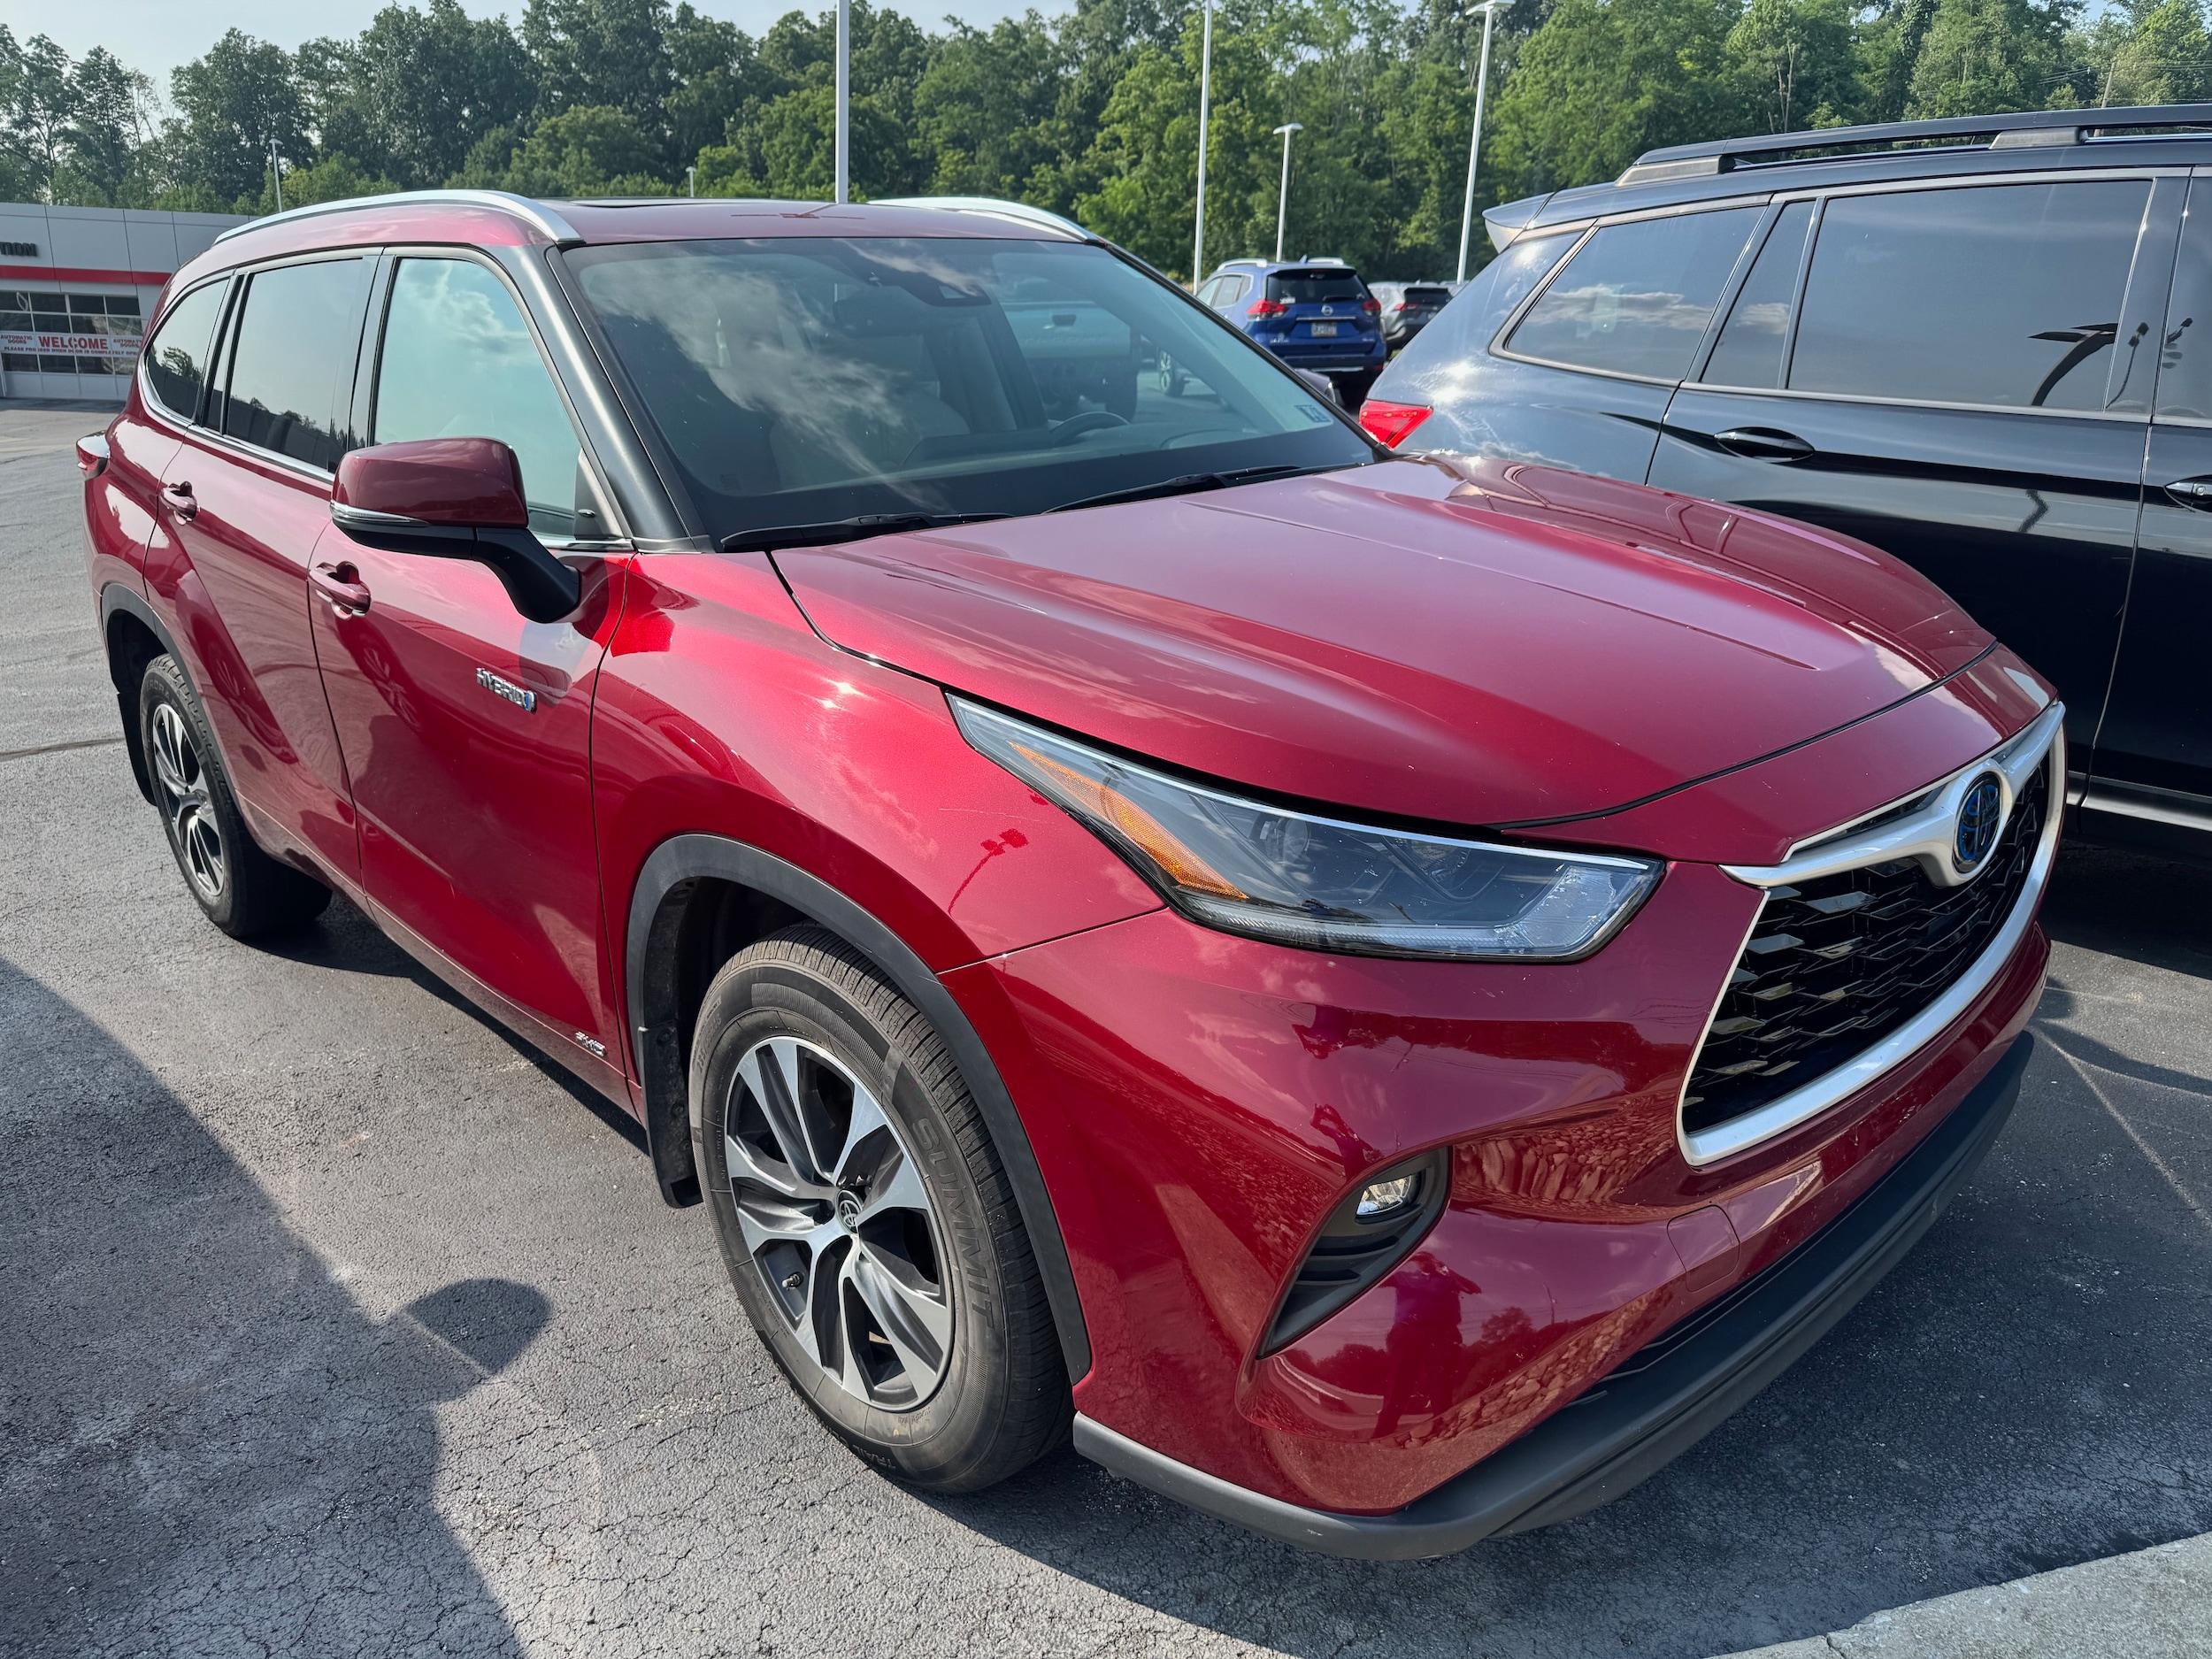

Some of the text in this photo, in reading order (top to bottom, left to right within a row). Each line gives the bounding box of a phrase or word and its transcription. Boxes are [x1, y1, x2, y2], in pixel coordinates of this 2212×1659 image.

[38, 335, 108, 349] WELCOME
[476, 667, 526, 709] HYBRID
[912, 1118, 995, 1328] SUMMIT
